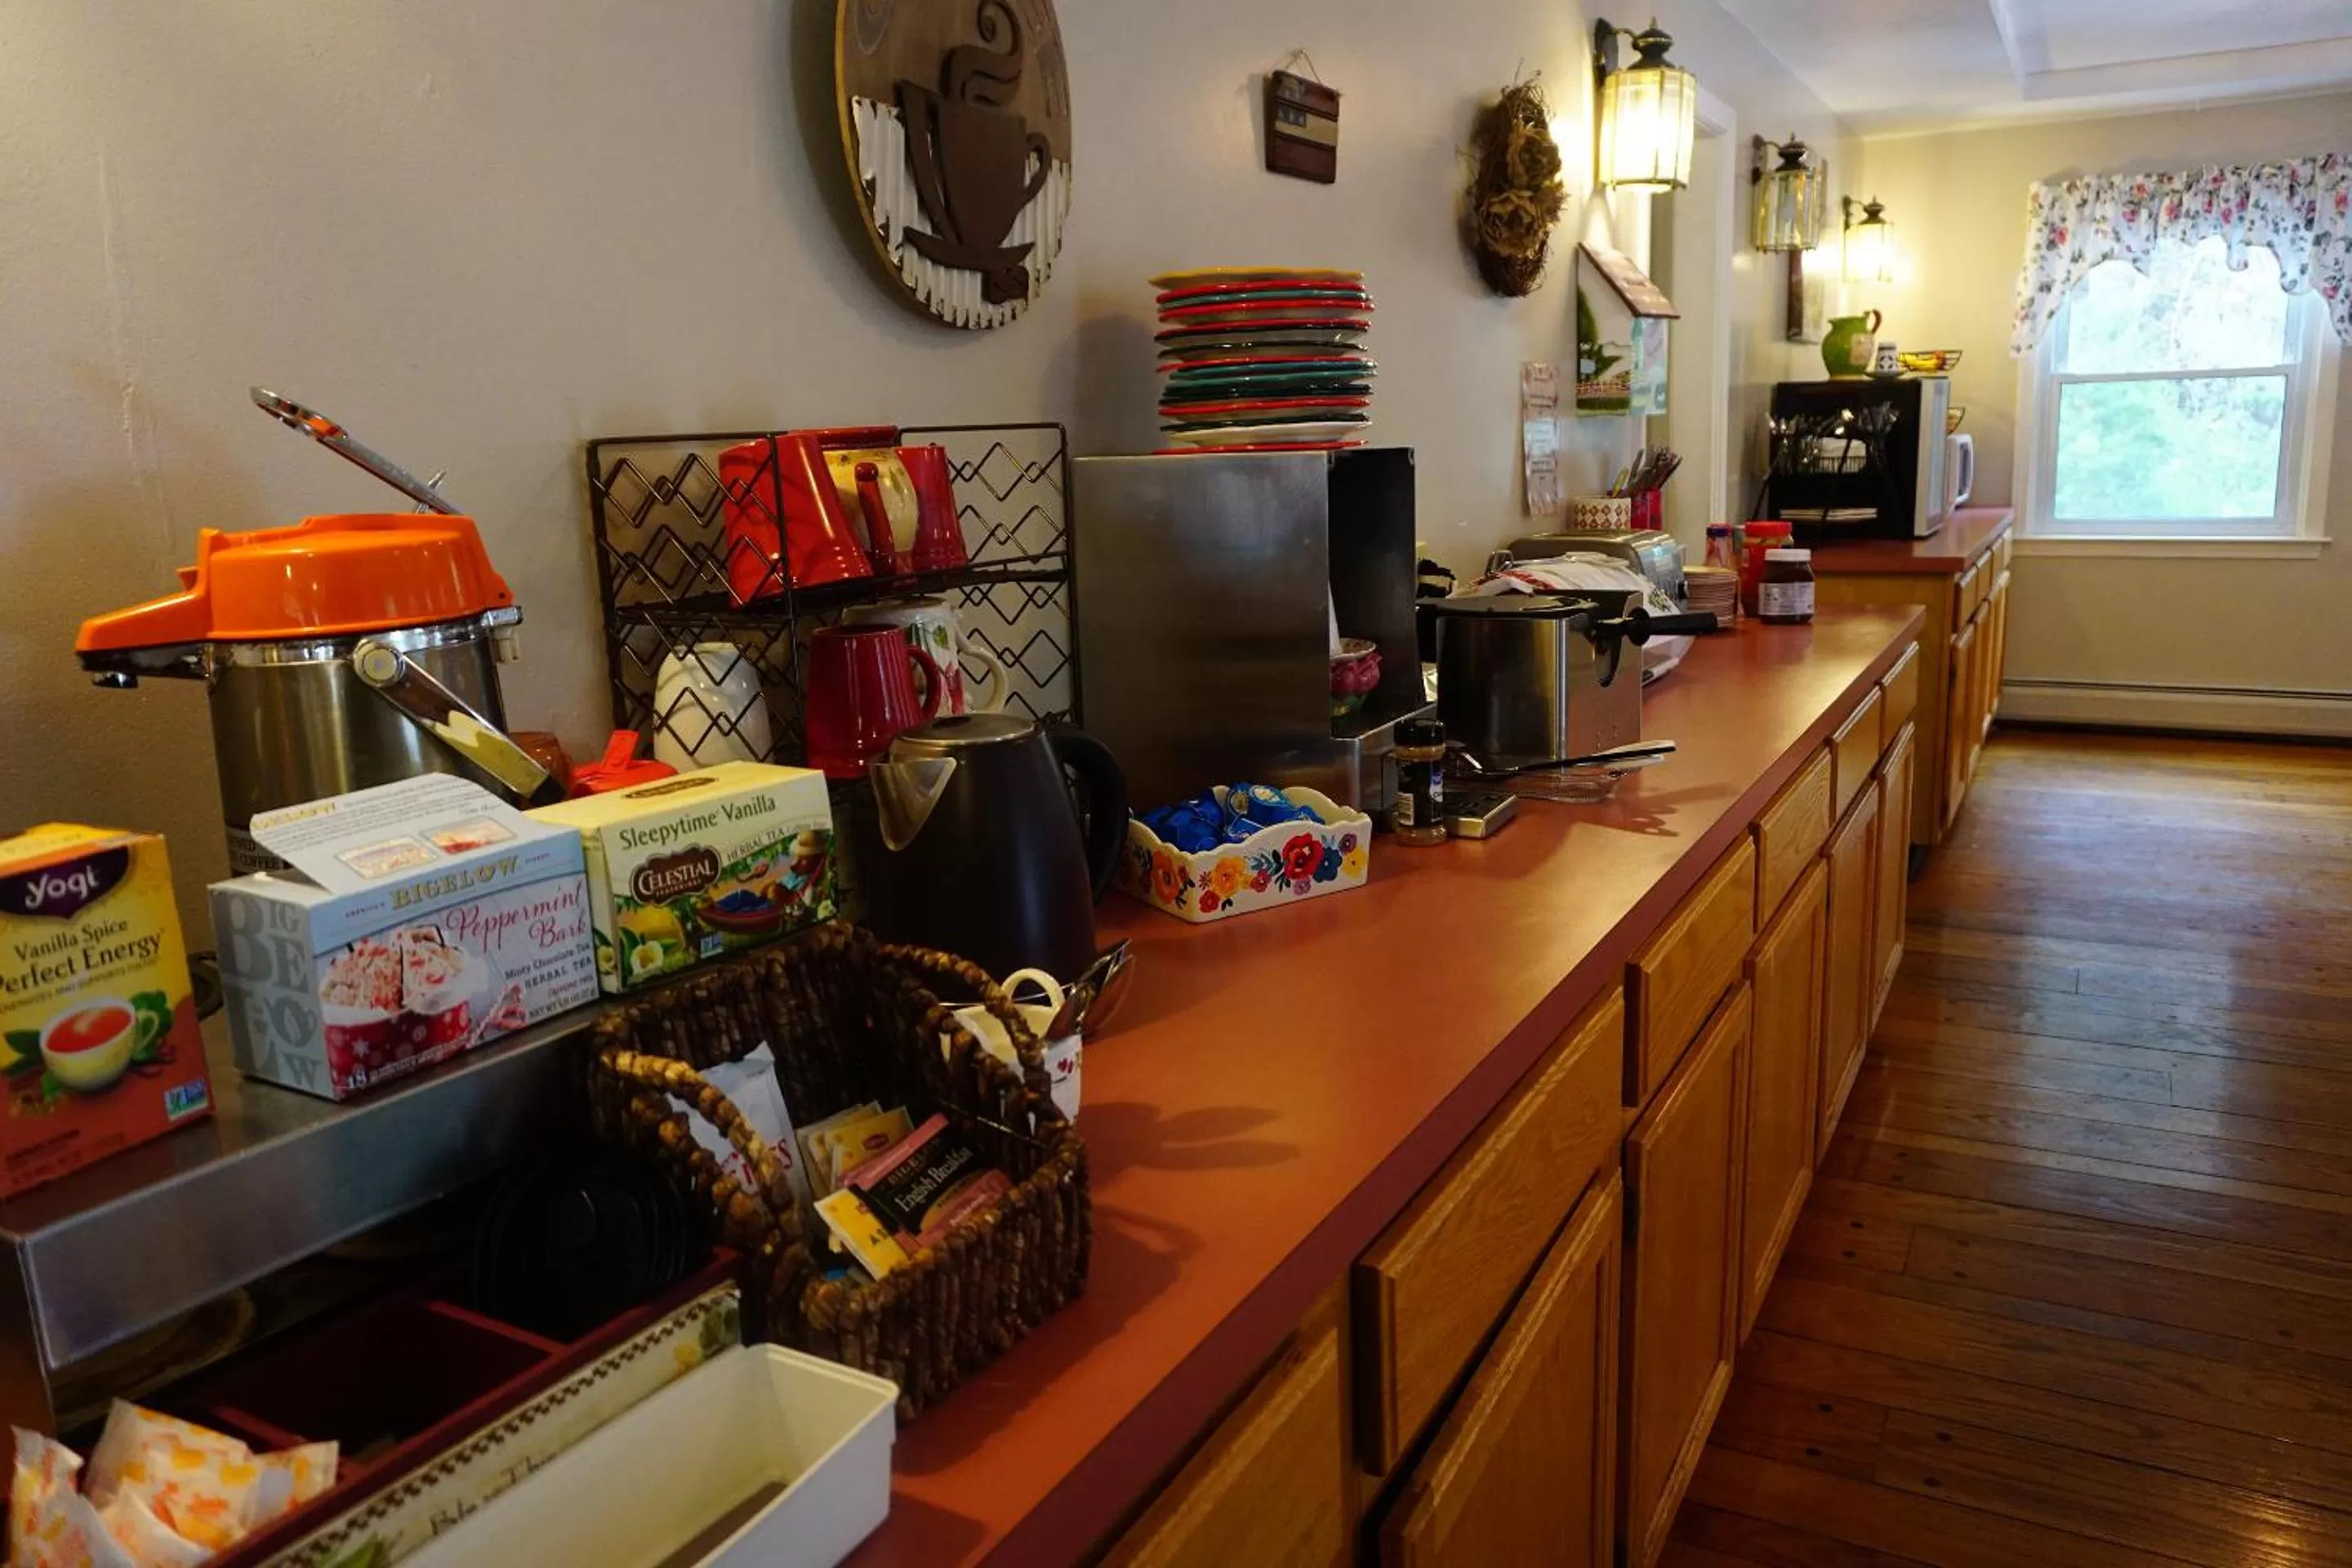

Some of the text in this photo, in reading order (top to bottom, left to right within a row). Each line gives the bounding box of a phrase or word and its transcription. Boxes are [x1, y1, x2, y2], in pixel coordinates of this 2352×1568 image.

[619, 794, 776, 851] Sleepytime Vanilla
[390, 855, 519, 910] BIGELOW
[637, 858, 715, 896] CELESTIAL
[445, 880, 583, 953] Peppermint
[528, 907, 586, 949] Bark
[14, 918, 128, 961] Vanilla Spice
[82, 933, 161, 969] Energy
[893, 1176, 938, 1212] English
